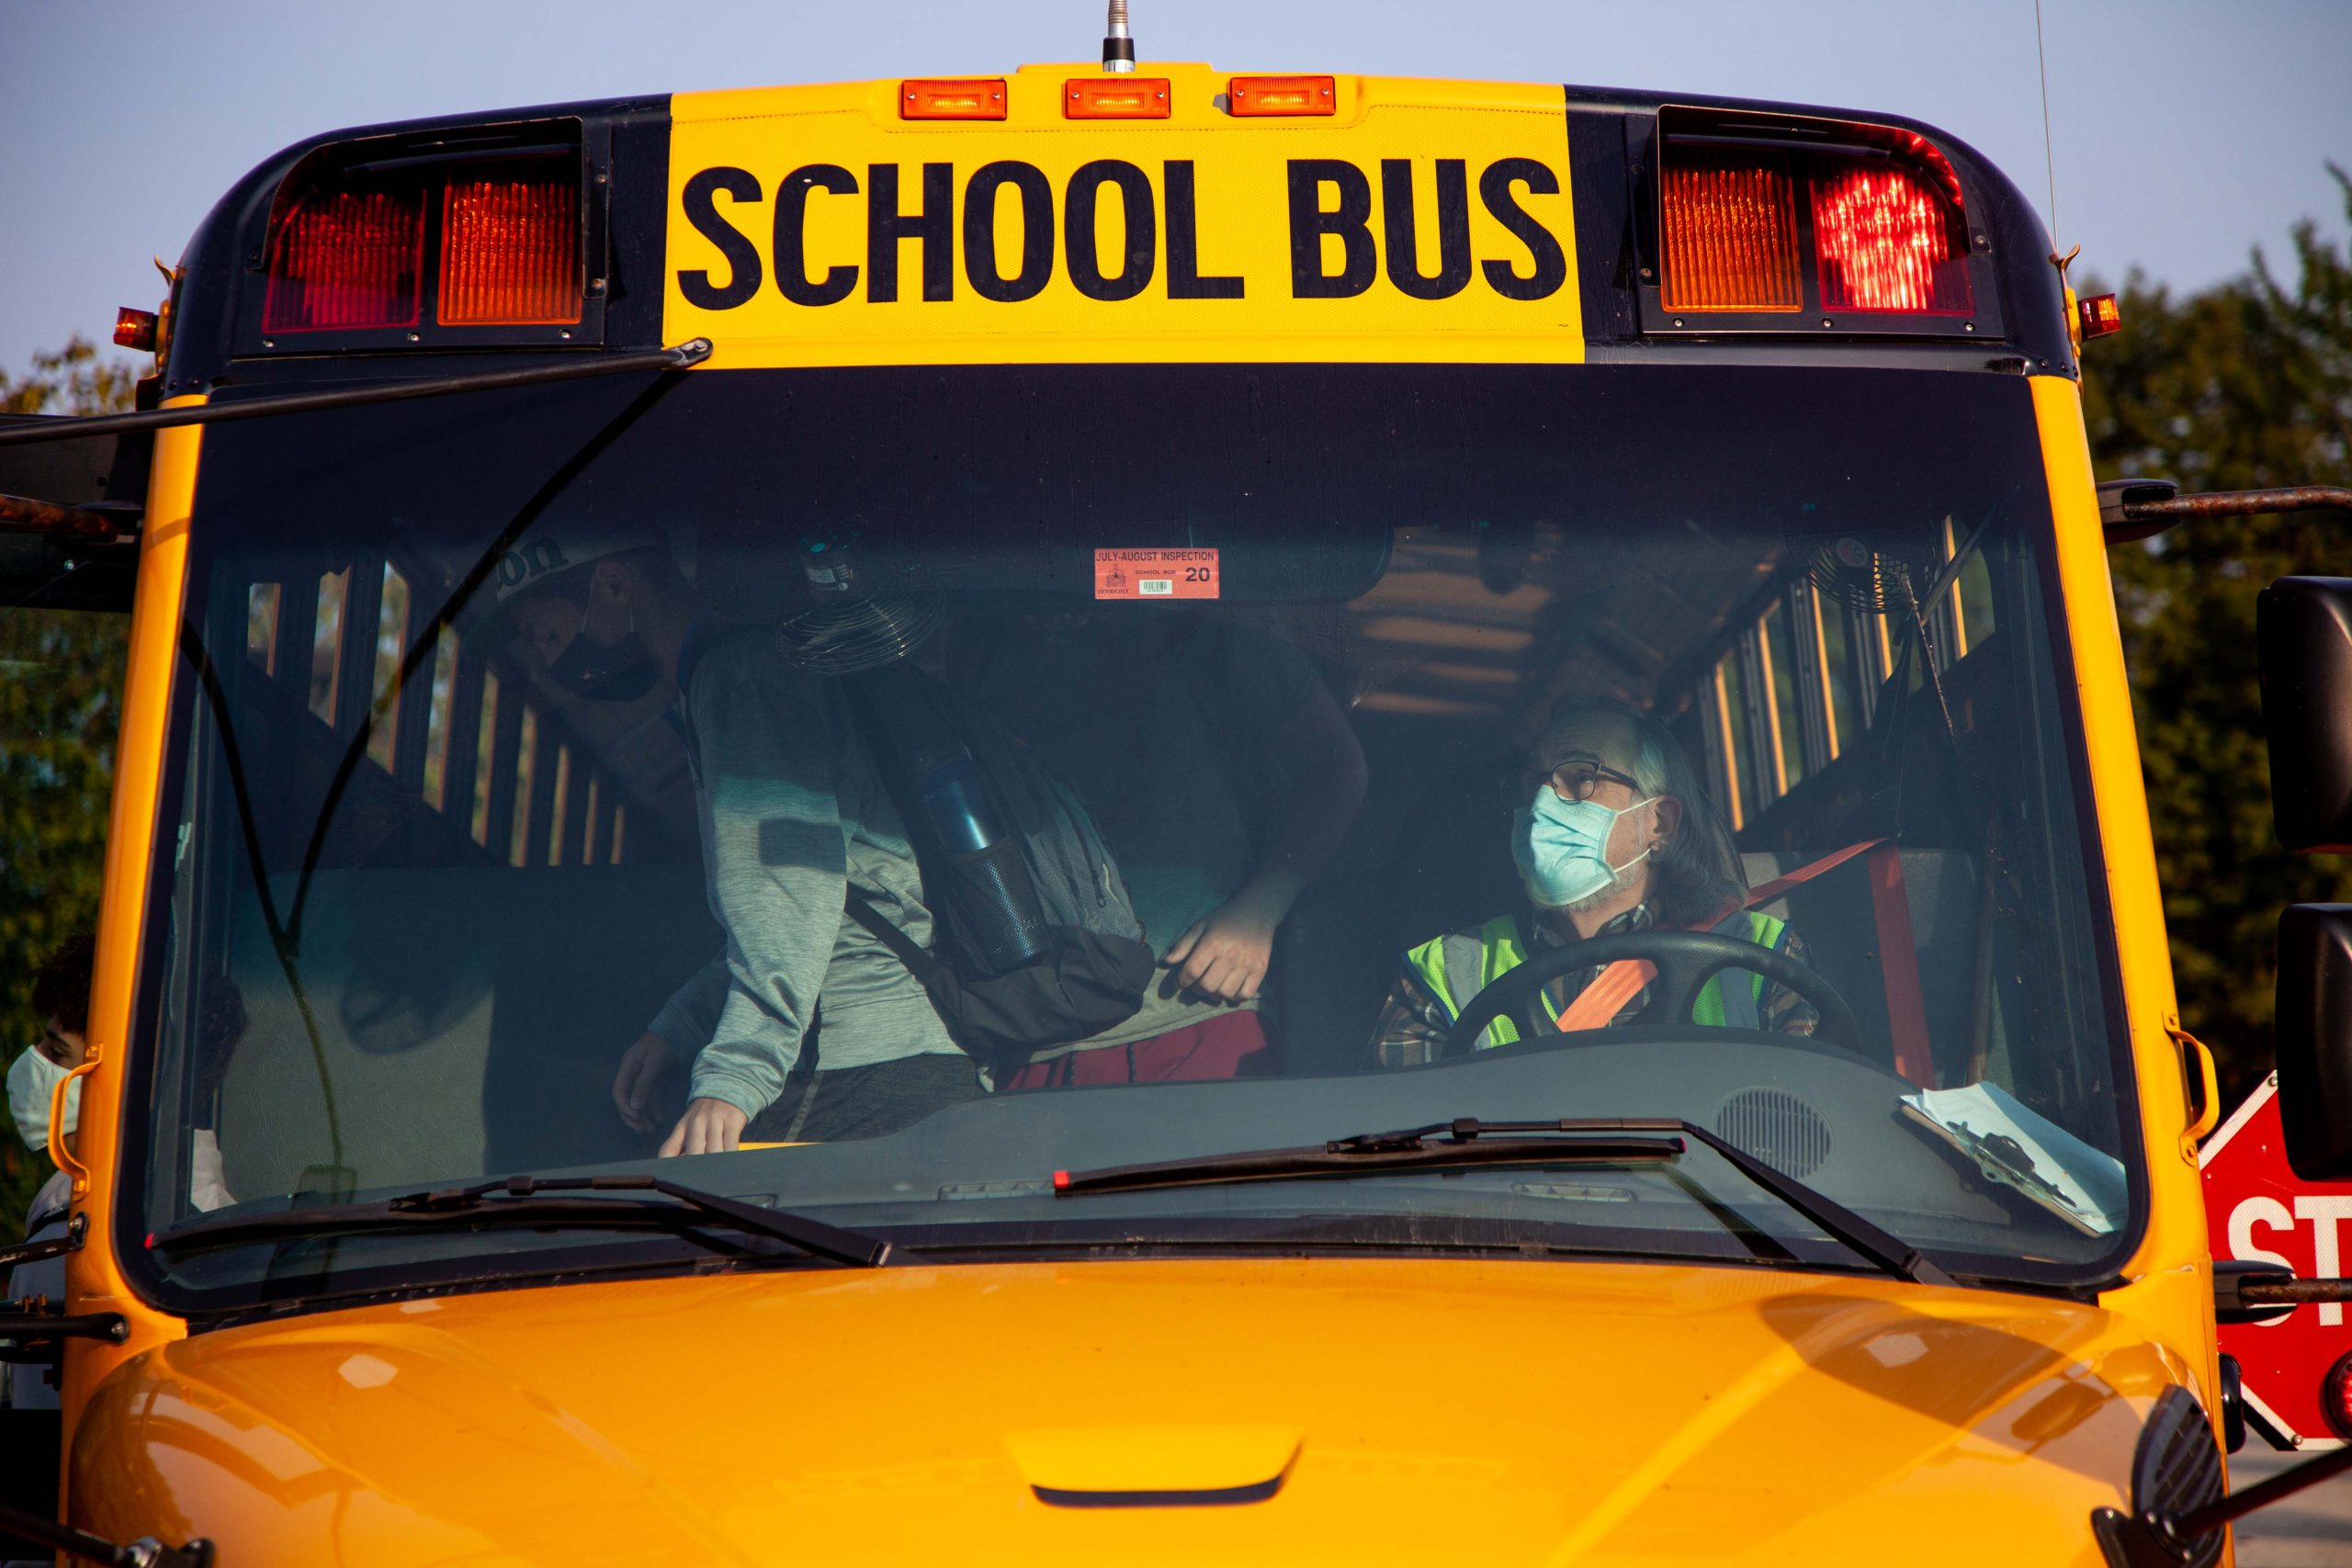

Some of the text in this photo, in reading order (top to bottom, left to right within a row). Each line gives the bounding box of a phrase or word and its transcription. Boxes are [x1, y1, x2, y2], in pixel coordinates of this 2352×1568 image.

[675, 157, 1567, 310] SCHOOL BUS
[1096, 551, 1215, 561] JULY-AUGUST INSPECTION
[1185, 567, 1211, 582] 20
